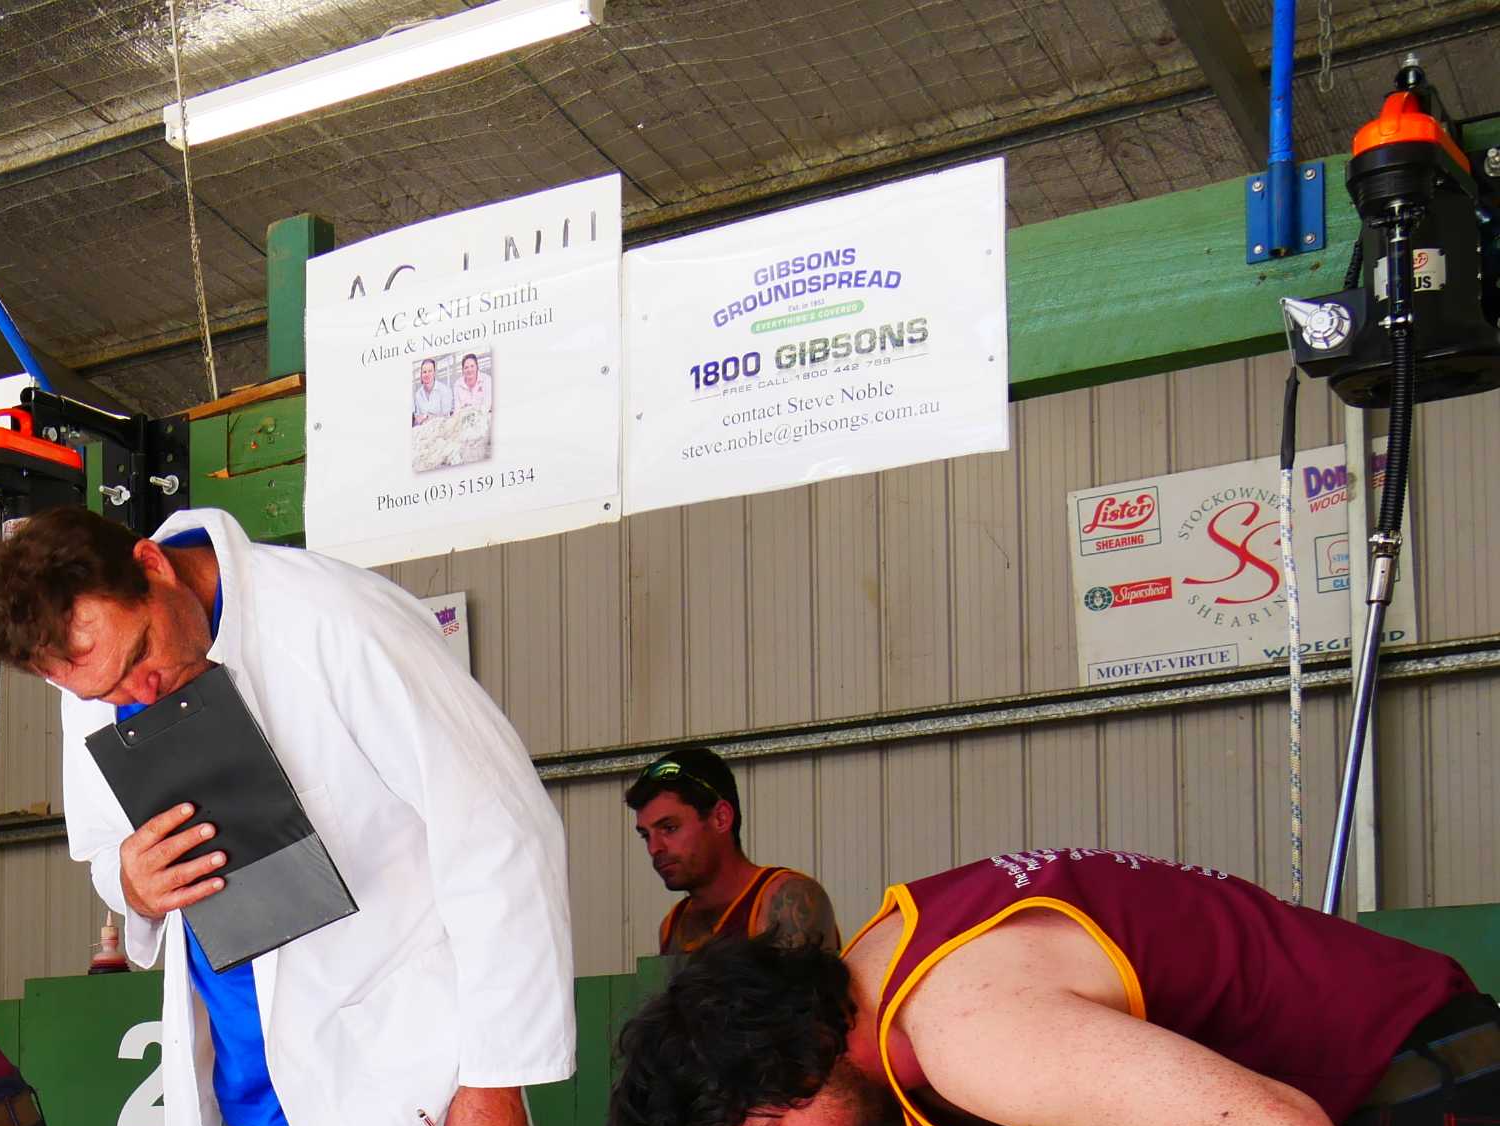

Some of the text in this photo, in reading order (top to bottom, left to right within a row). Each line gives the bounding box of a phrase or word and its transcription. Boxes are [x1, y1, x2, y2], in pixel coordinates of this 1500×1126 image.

[754, 248, 857, 286] GIBSONS
[374, 283, 539, 337] AC & NH Smith
[712, 269, 902, 328] GROUNDSPREAD
[817, 303, 860, 319] COVERED
[360, 307, 554, 369] (Alan & Noeleen) Innisfail
[689, 317, 930, 390] 1800 GIBSONS
[721, 381, 895, 427] contact Steve Noble
[681, 400, 941, 461] steve.noble@gibsongs.com.au
[376, 466, 535, 512] Phone (03) 5159 1334
[1082, 494, 1156, 535] Lister
[1095, 533, 1146, 552] SHEARING
[1096, 649, 1231, 681] MOFFAT-VIRTUE
